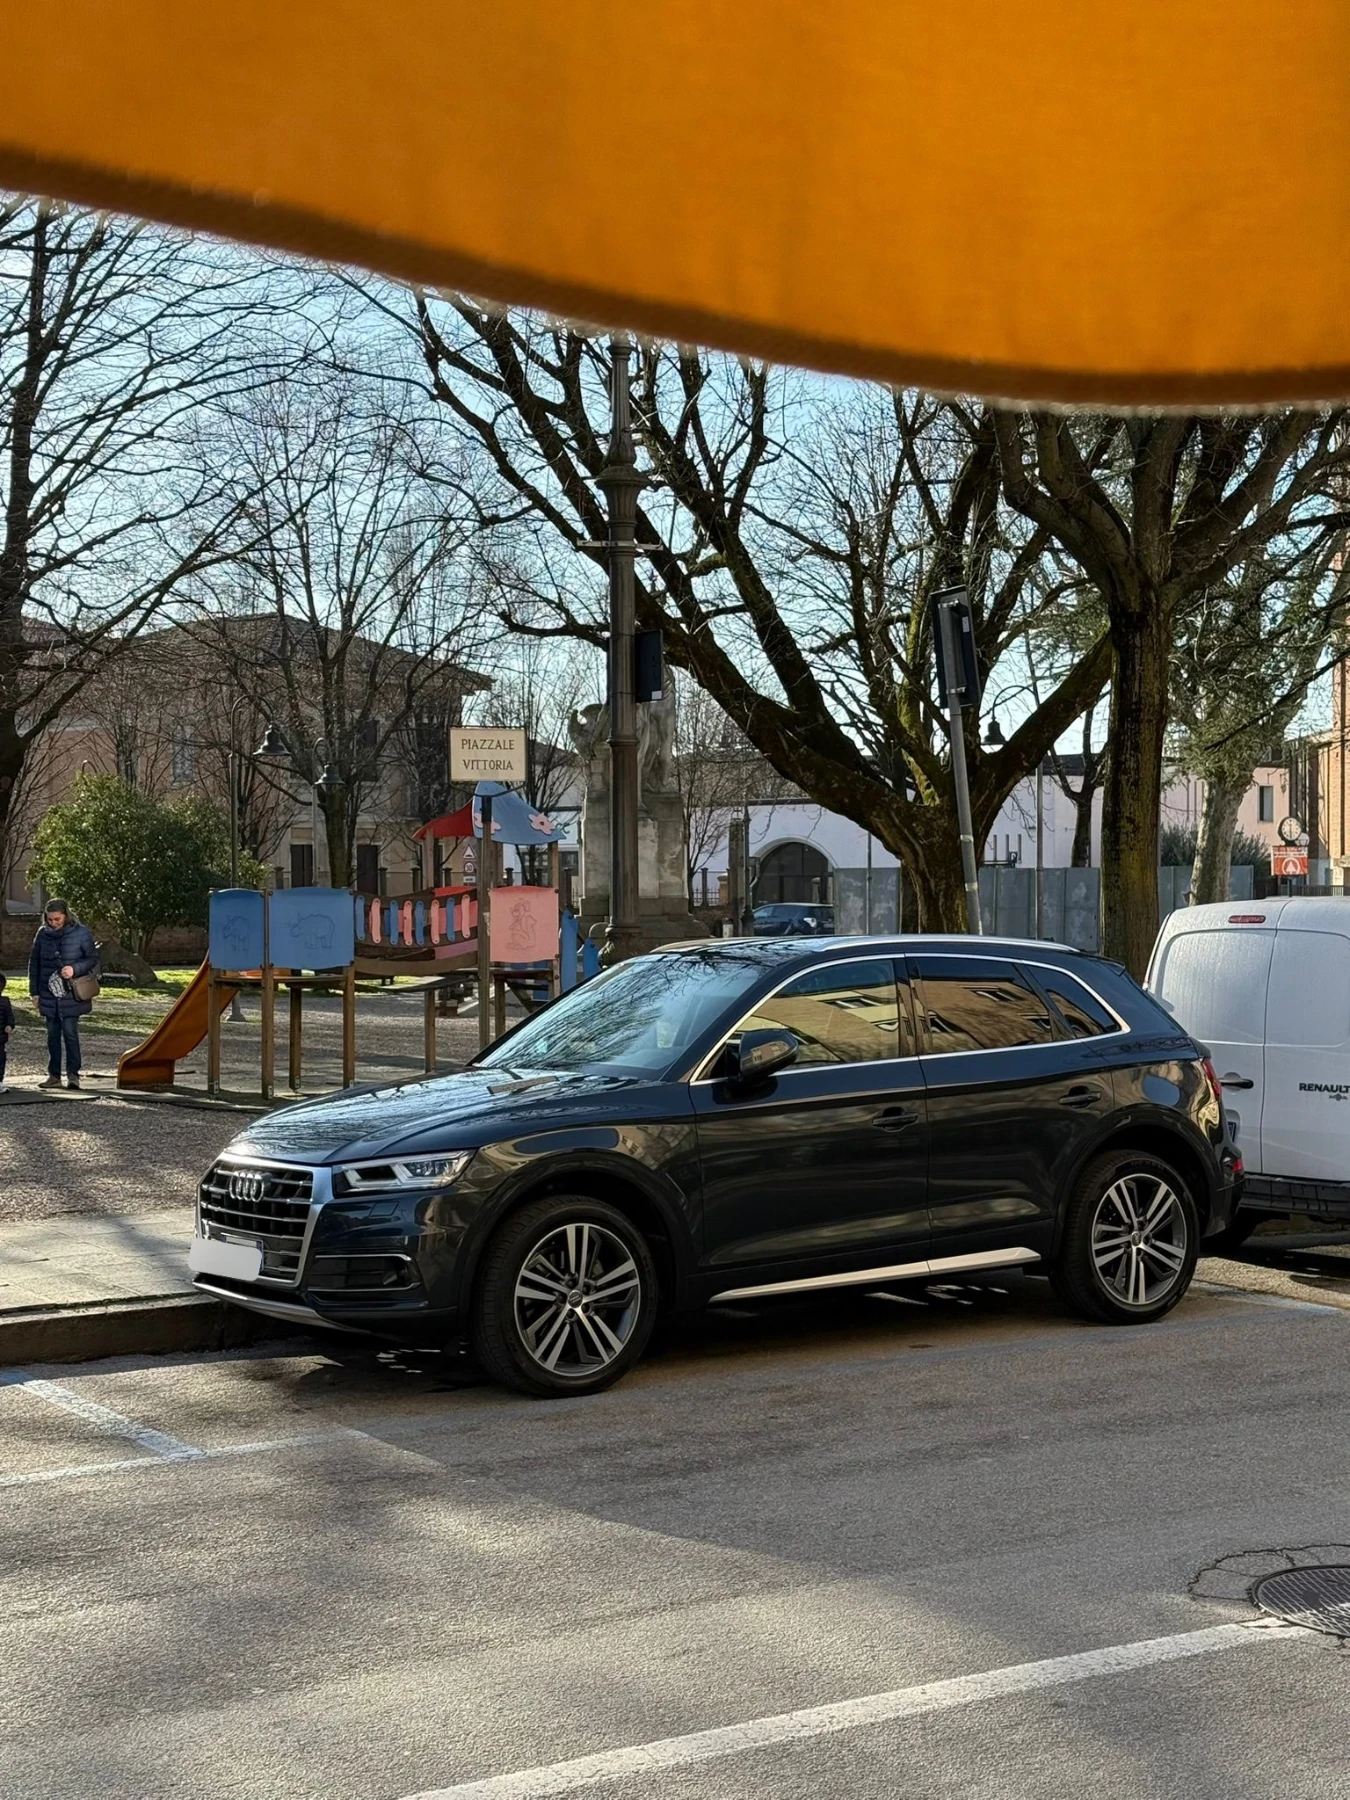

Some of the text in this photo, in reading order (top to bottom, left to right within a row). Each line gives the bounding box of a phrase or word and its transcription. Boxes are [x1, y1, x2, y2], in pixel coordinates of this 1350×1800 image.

[461, 738, 515, 750] PIAZZALE
[462, 759, 514, 771] VITTORIA
[1299, 1082, 1350, 1094] RENAULT
